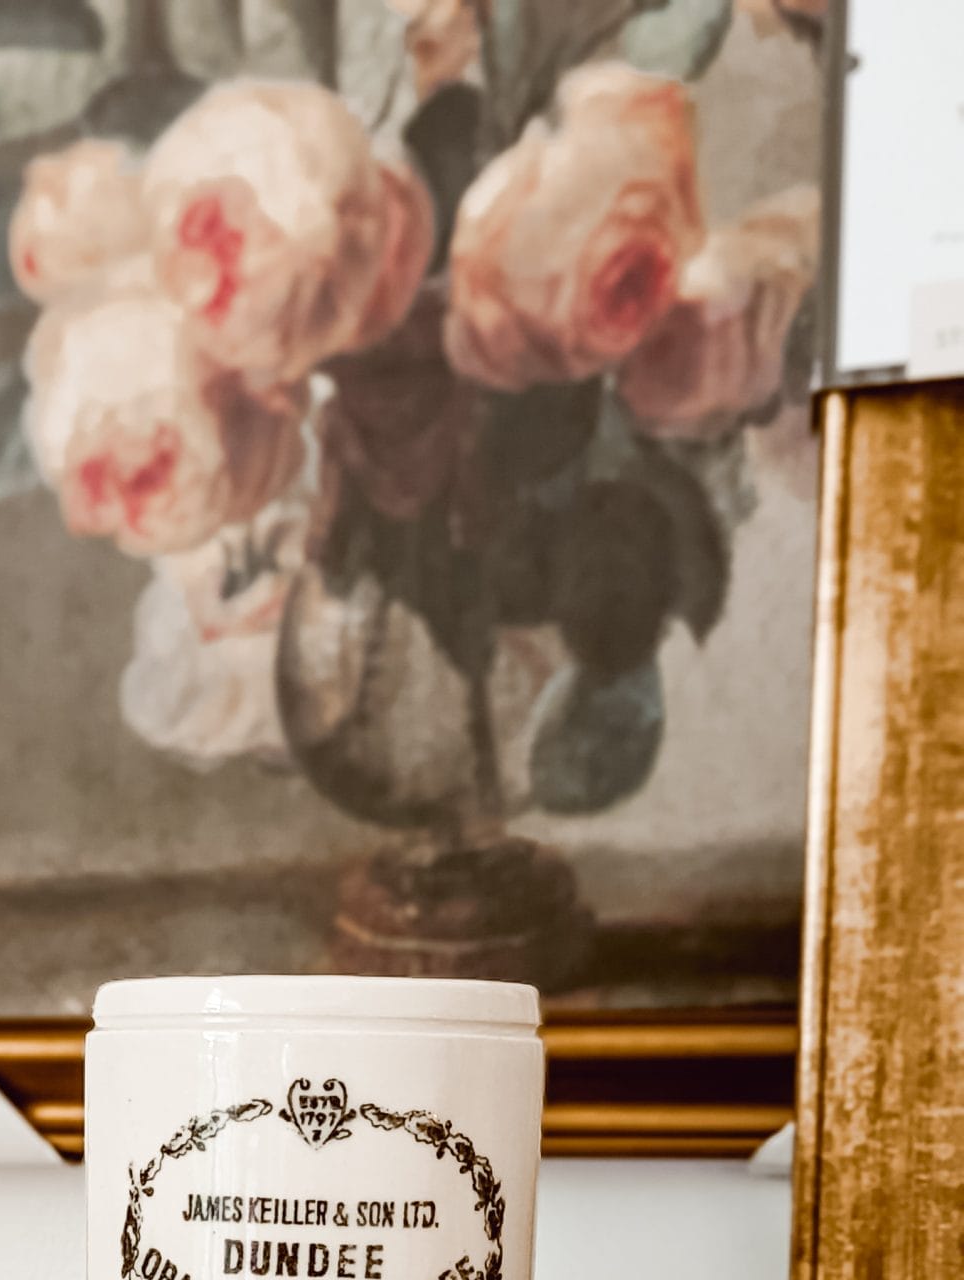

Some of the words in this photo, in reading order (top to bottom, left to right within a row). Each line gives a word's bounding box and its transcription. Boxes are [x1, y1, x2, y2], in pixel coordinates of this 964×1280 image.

[182, 1193, 243, 1223] JAMES
[248, 1196, 328, 1226] KEILLER
[332, 1201, 349, 1228] &
[356, 1201, 395, 1228] SON
[223, 1238, 384, 1280] DUNDEE
